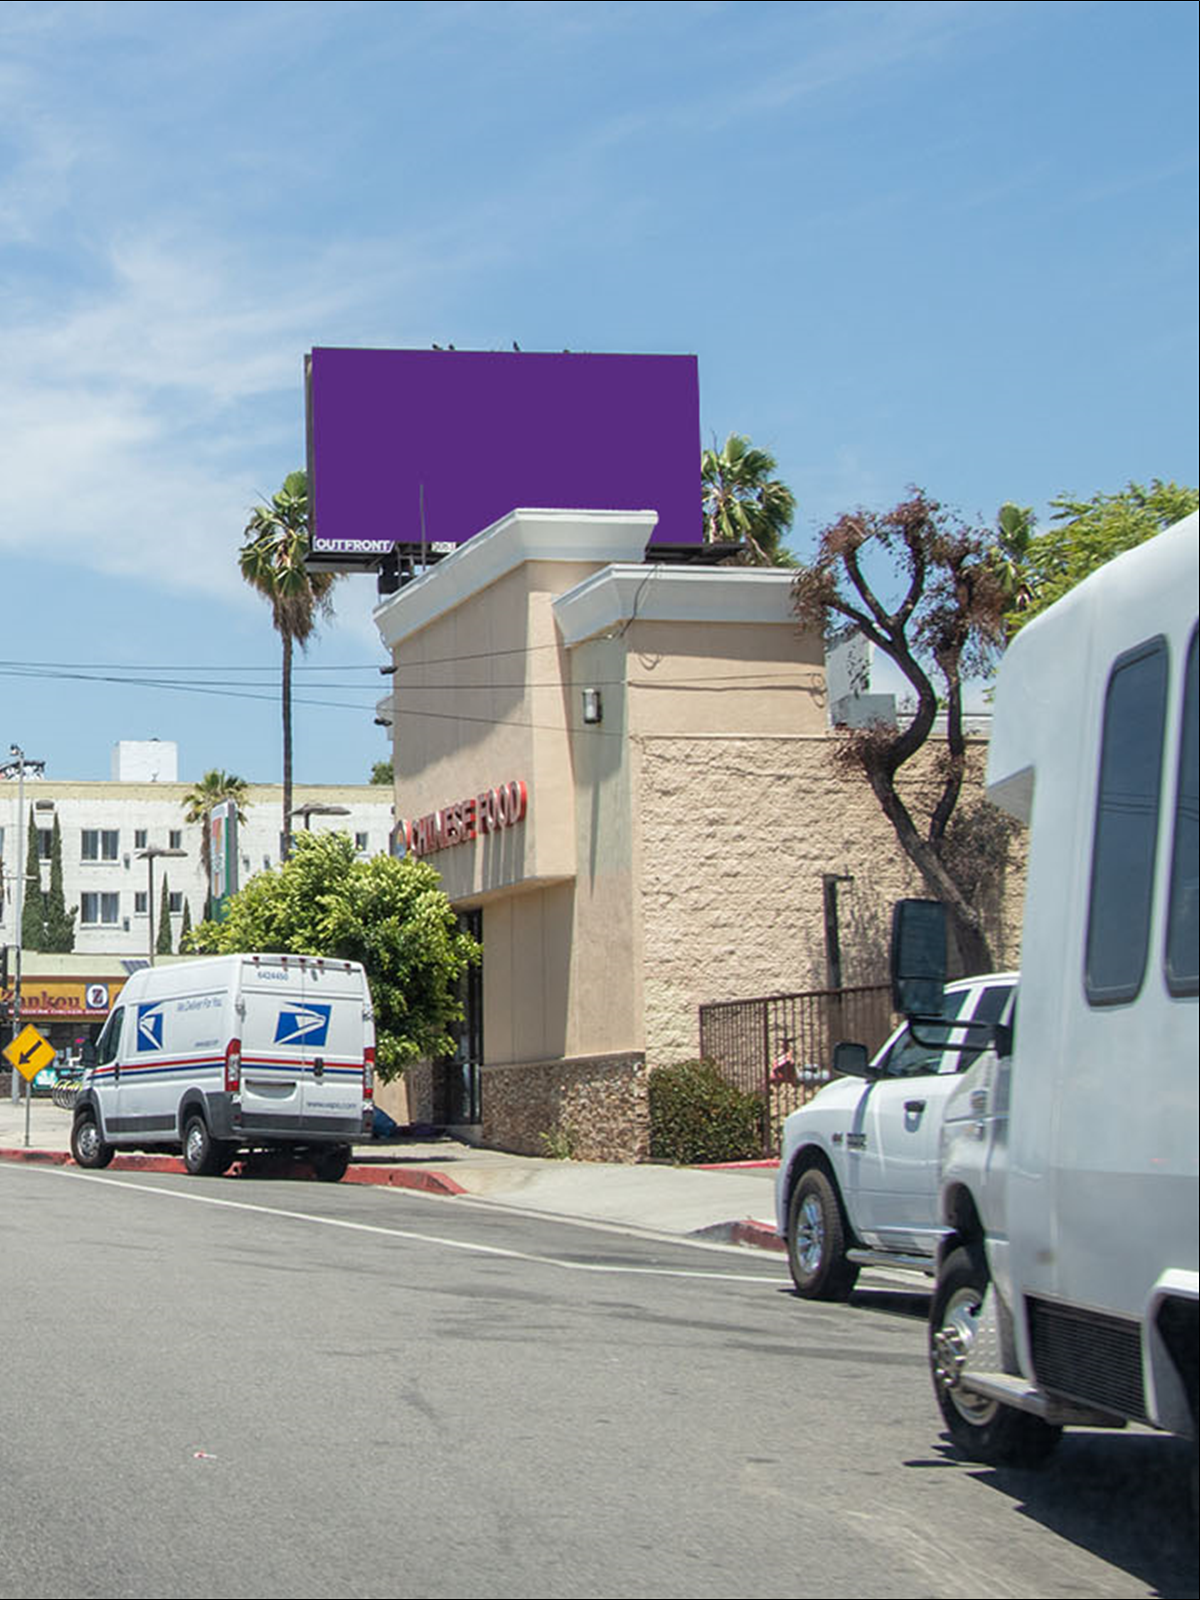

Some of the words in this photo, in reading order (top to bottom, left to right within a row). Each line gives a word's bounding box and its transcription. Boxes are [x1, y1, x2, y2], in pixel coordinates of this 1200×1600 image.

[316, 538, 390, 551] OUTFRONT
[411, 799, 477, 857] CHINESE
[477, 780, 527, 835] FOOD
[92, 988, 104, 1004] Z
